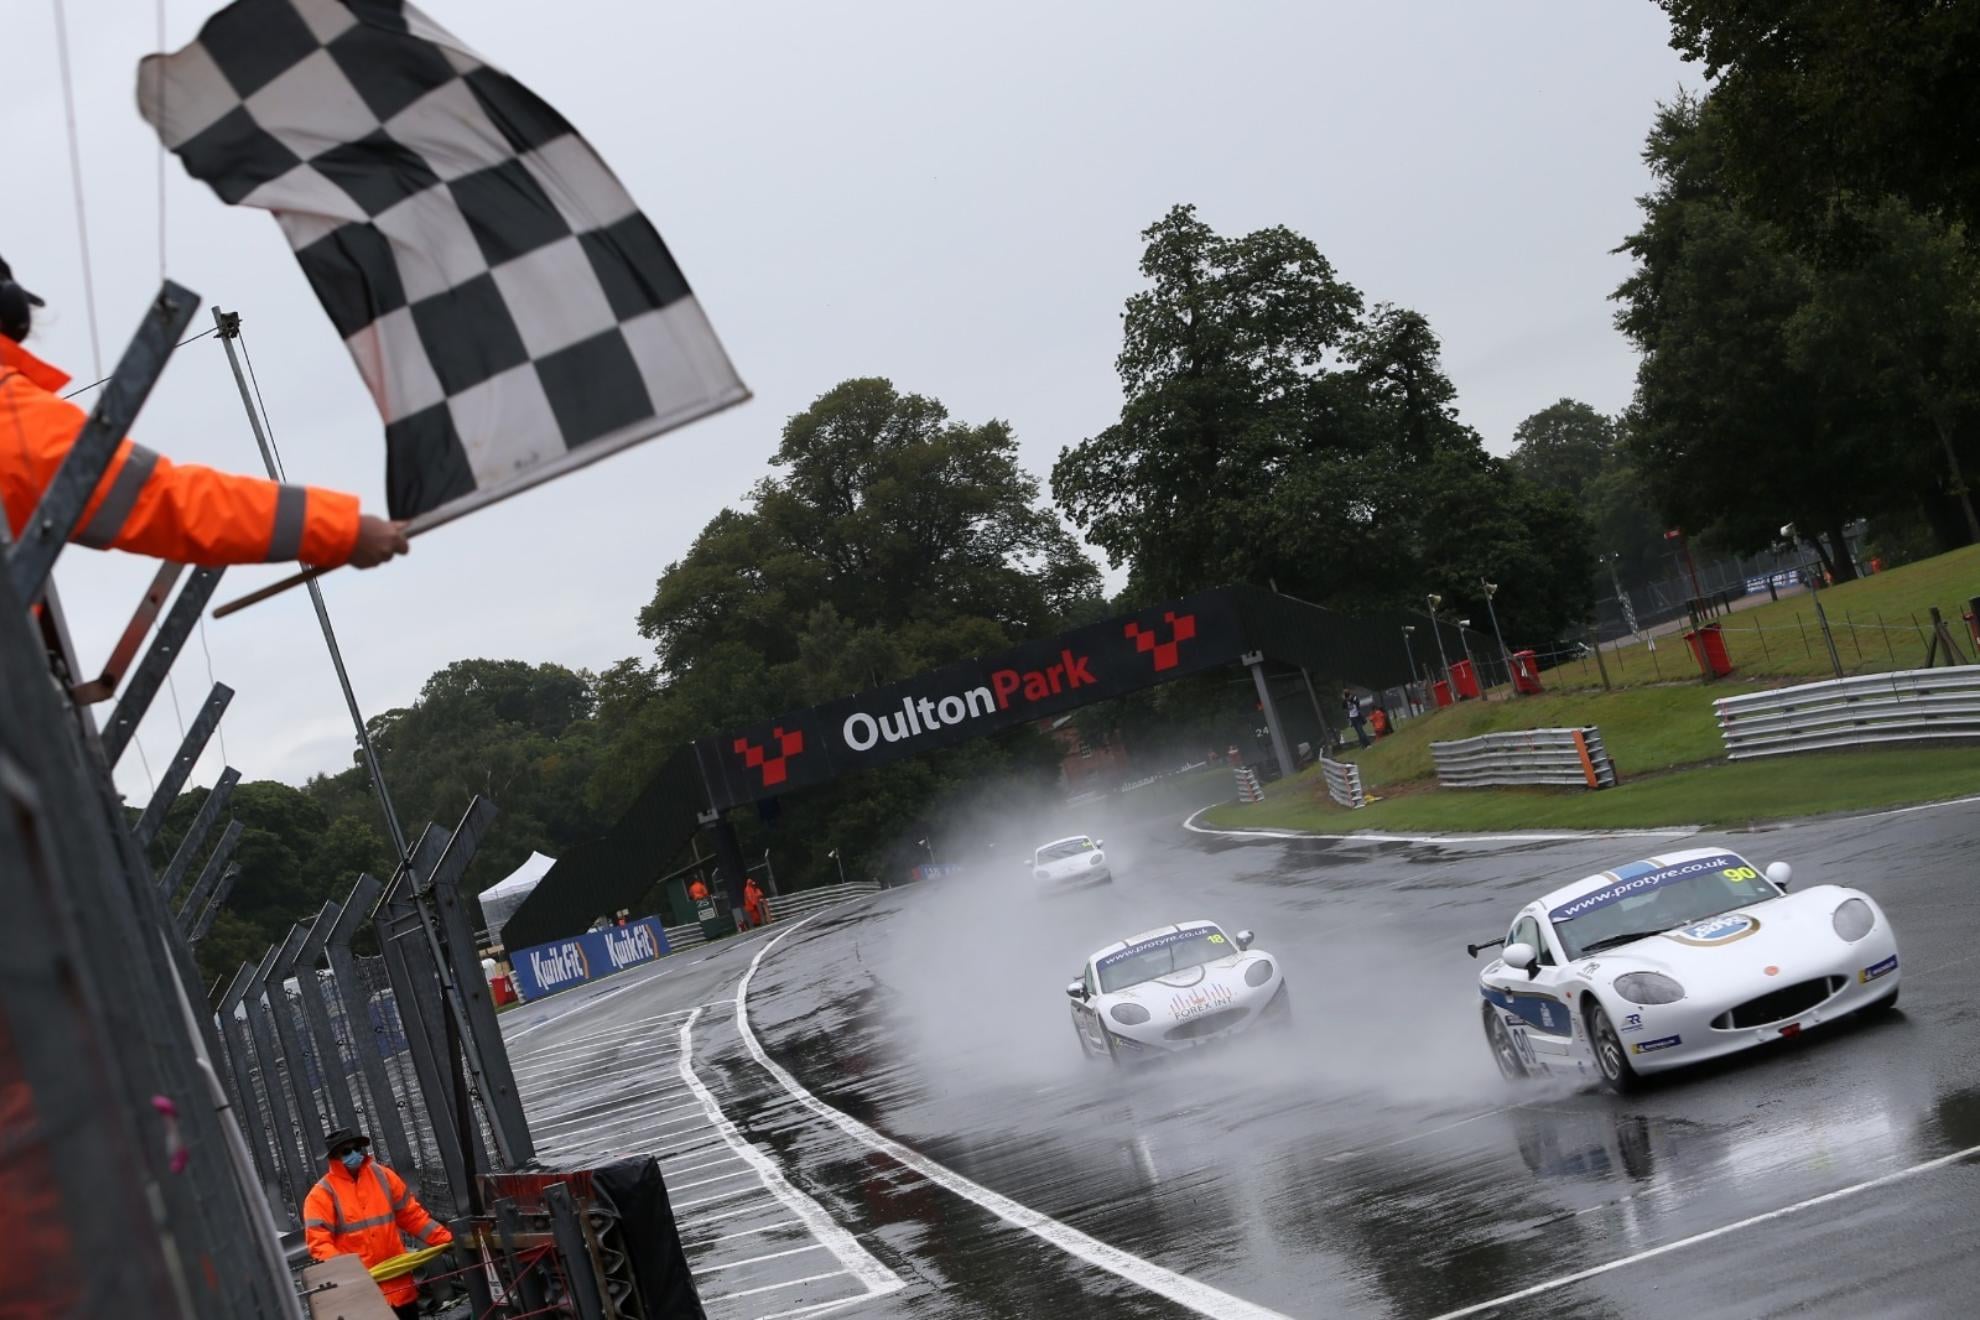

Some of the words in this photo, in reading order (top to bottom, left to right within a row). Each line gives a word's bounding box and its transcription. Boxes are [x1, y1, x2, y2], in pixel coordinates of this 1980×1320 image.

[1564, 857, 1729, 916] www.protyre.co.uk
[1723, 866, 1757, 883] 90
[1105, 928, 1208, 965] www.protyre.co.uk
[1175, 1003, 1212, 1020] FOREX
[1513, 1028, 1537, 1065] 90
